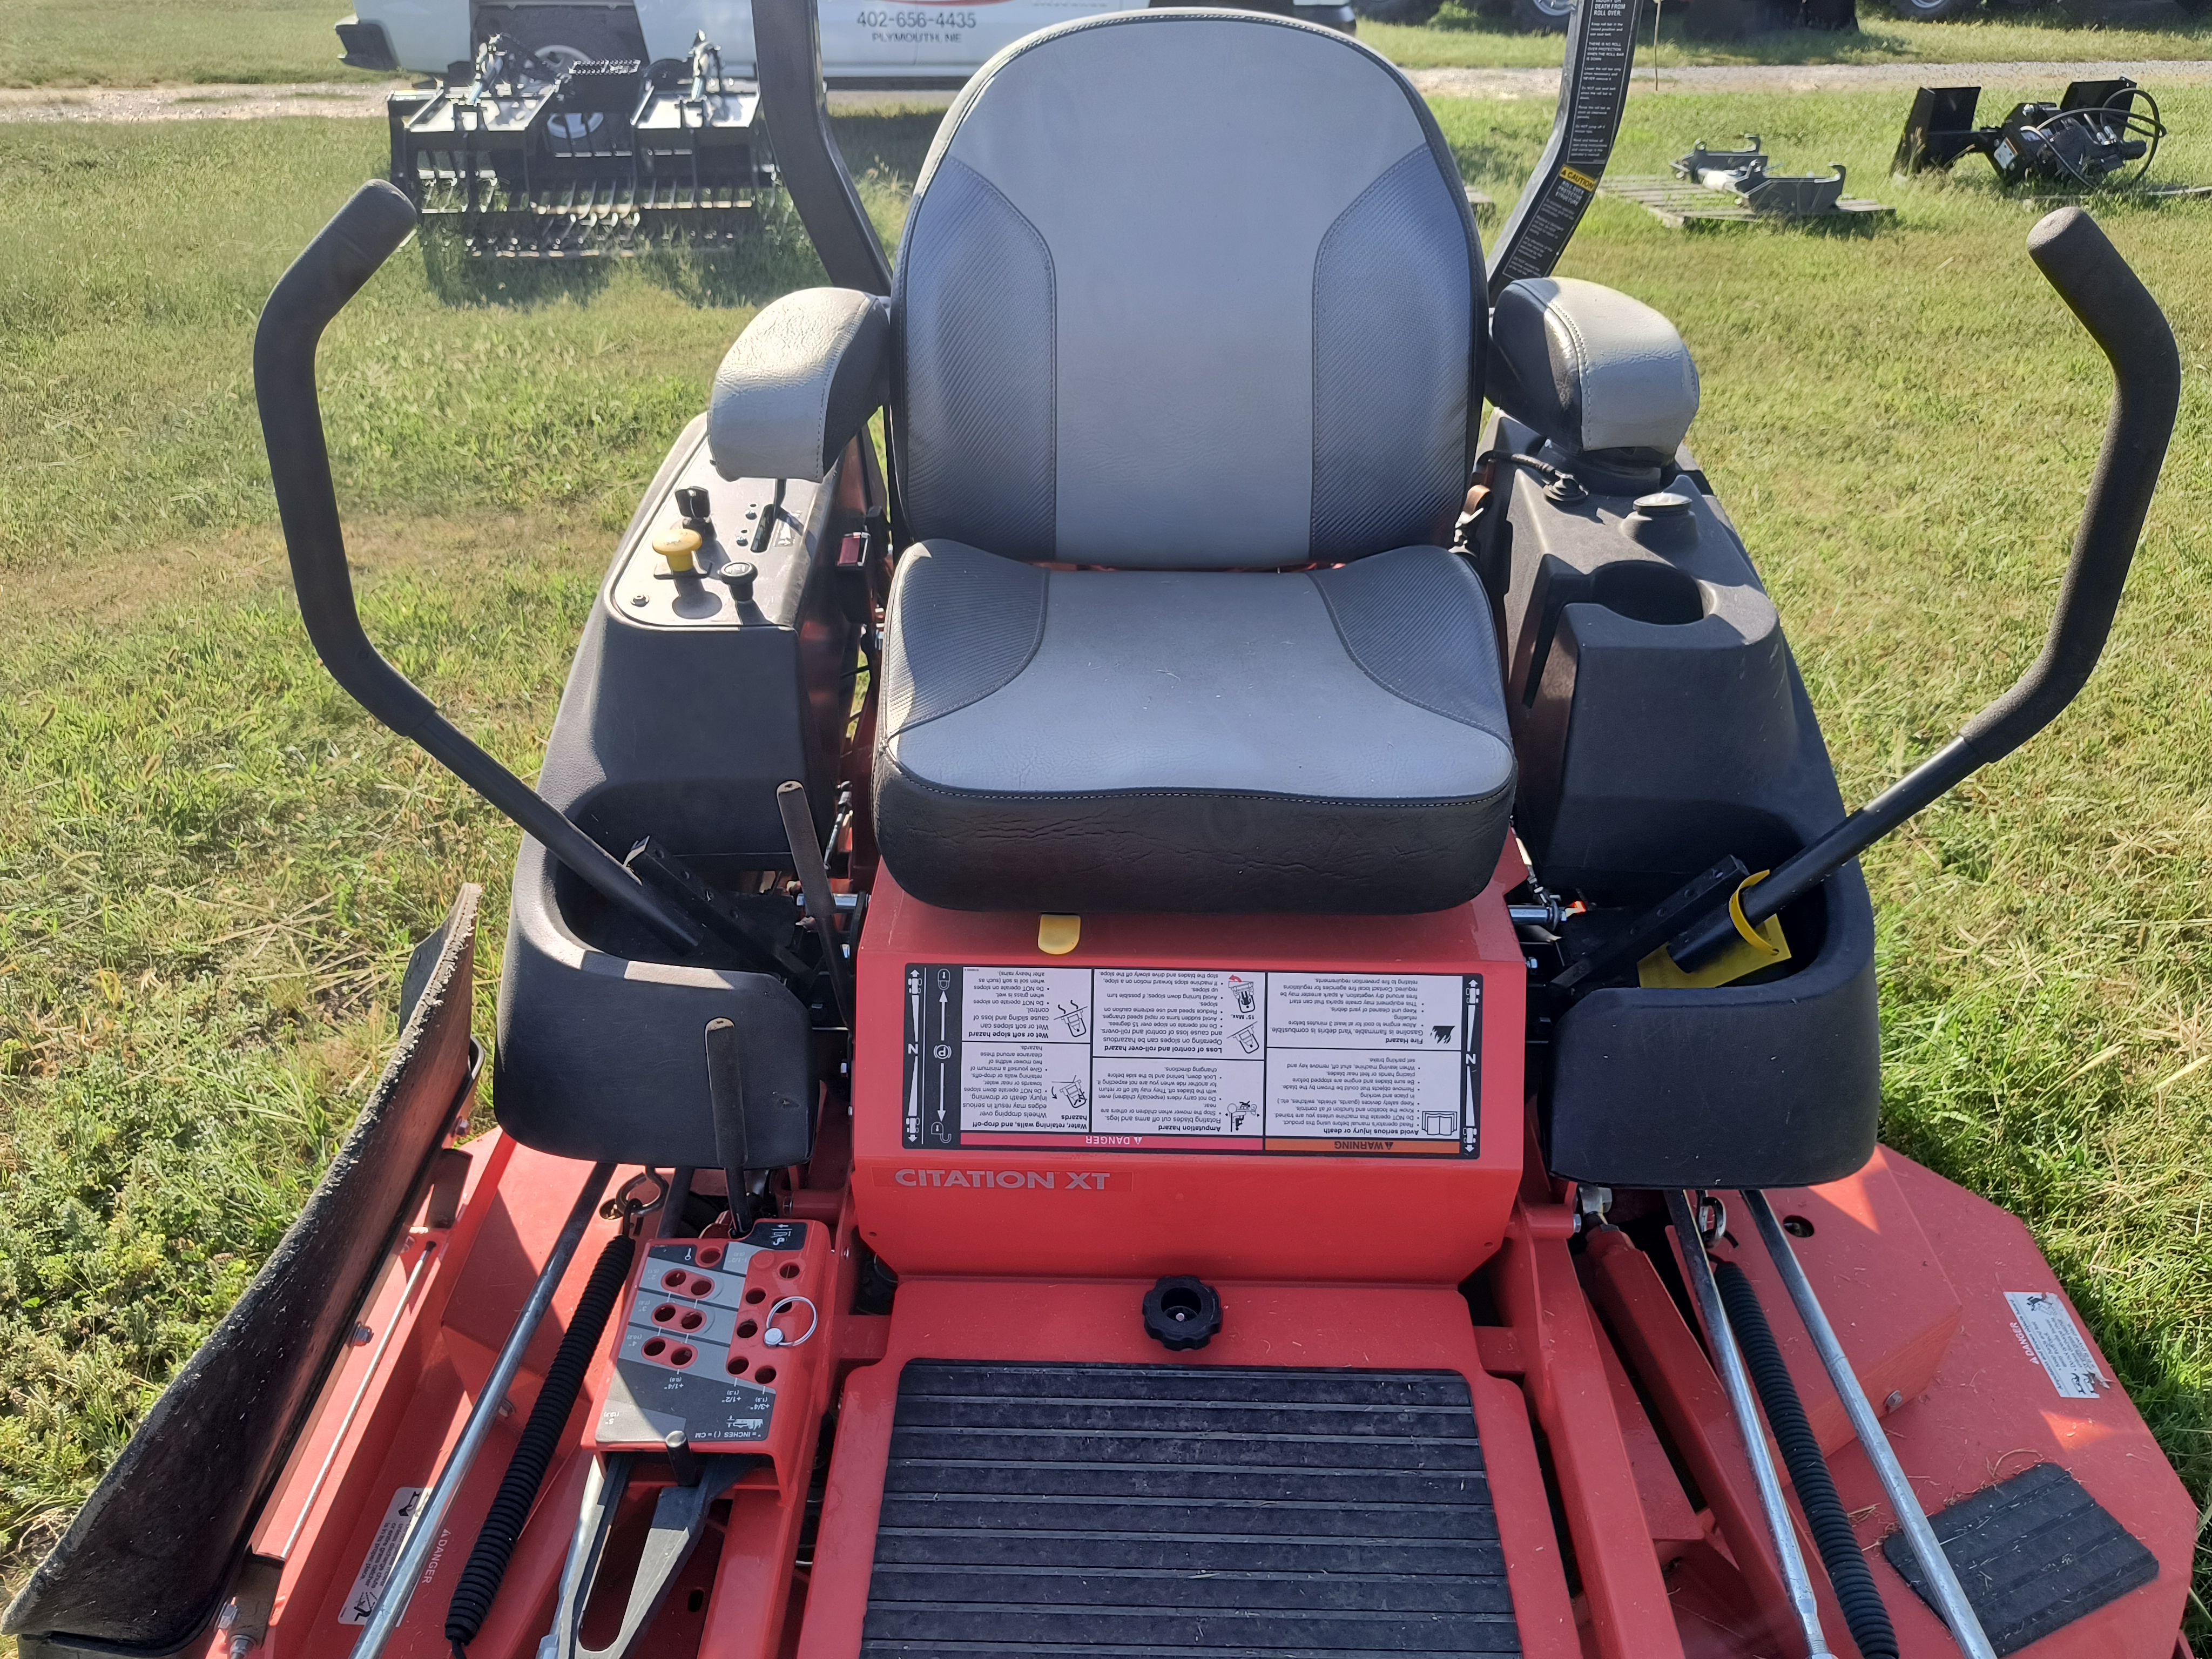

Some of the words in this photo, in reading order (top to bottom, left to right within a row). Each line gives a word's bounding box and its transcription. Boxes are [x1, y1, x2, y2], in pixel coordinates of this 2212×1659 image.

[857, 11, 976, 28] 402-656-4435
[945, 33, 962, 43] NE
[1567, 172, 1594, 189] CAUTION
[908, 1043, 918, 1054] N
[1191, 1037, 1222, 1045] Operating
[1465, 1054, 1476, 1064] N
[1085, 1136, 1130, 1145] DANGER
[1334, 1141, 1384, 1150] WARNING
[895, 1169, 1055, 1189] CITATION
[1064, 1171, 1110, 1190] XT
[2009, 1323, 2034, 1355] DANGER
[382, 1529, 394, 1547] entire
[391, 1522, 404, 1543] unless
[377, 1542, 396, 1572] discharge
[422, 1539, 449, 1583] DANGER
[364, 1563, 378, 1587] catcher
